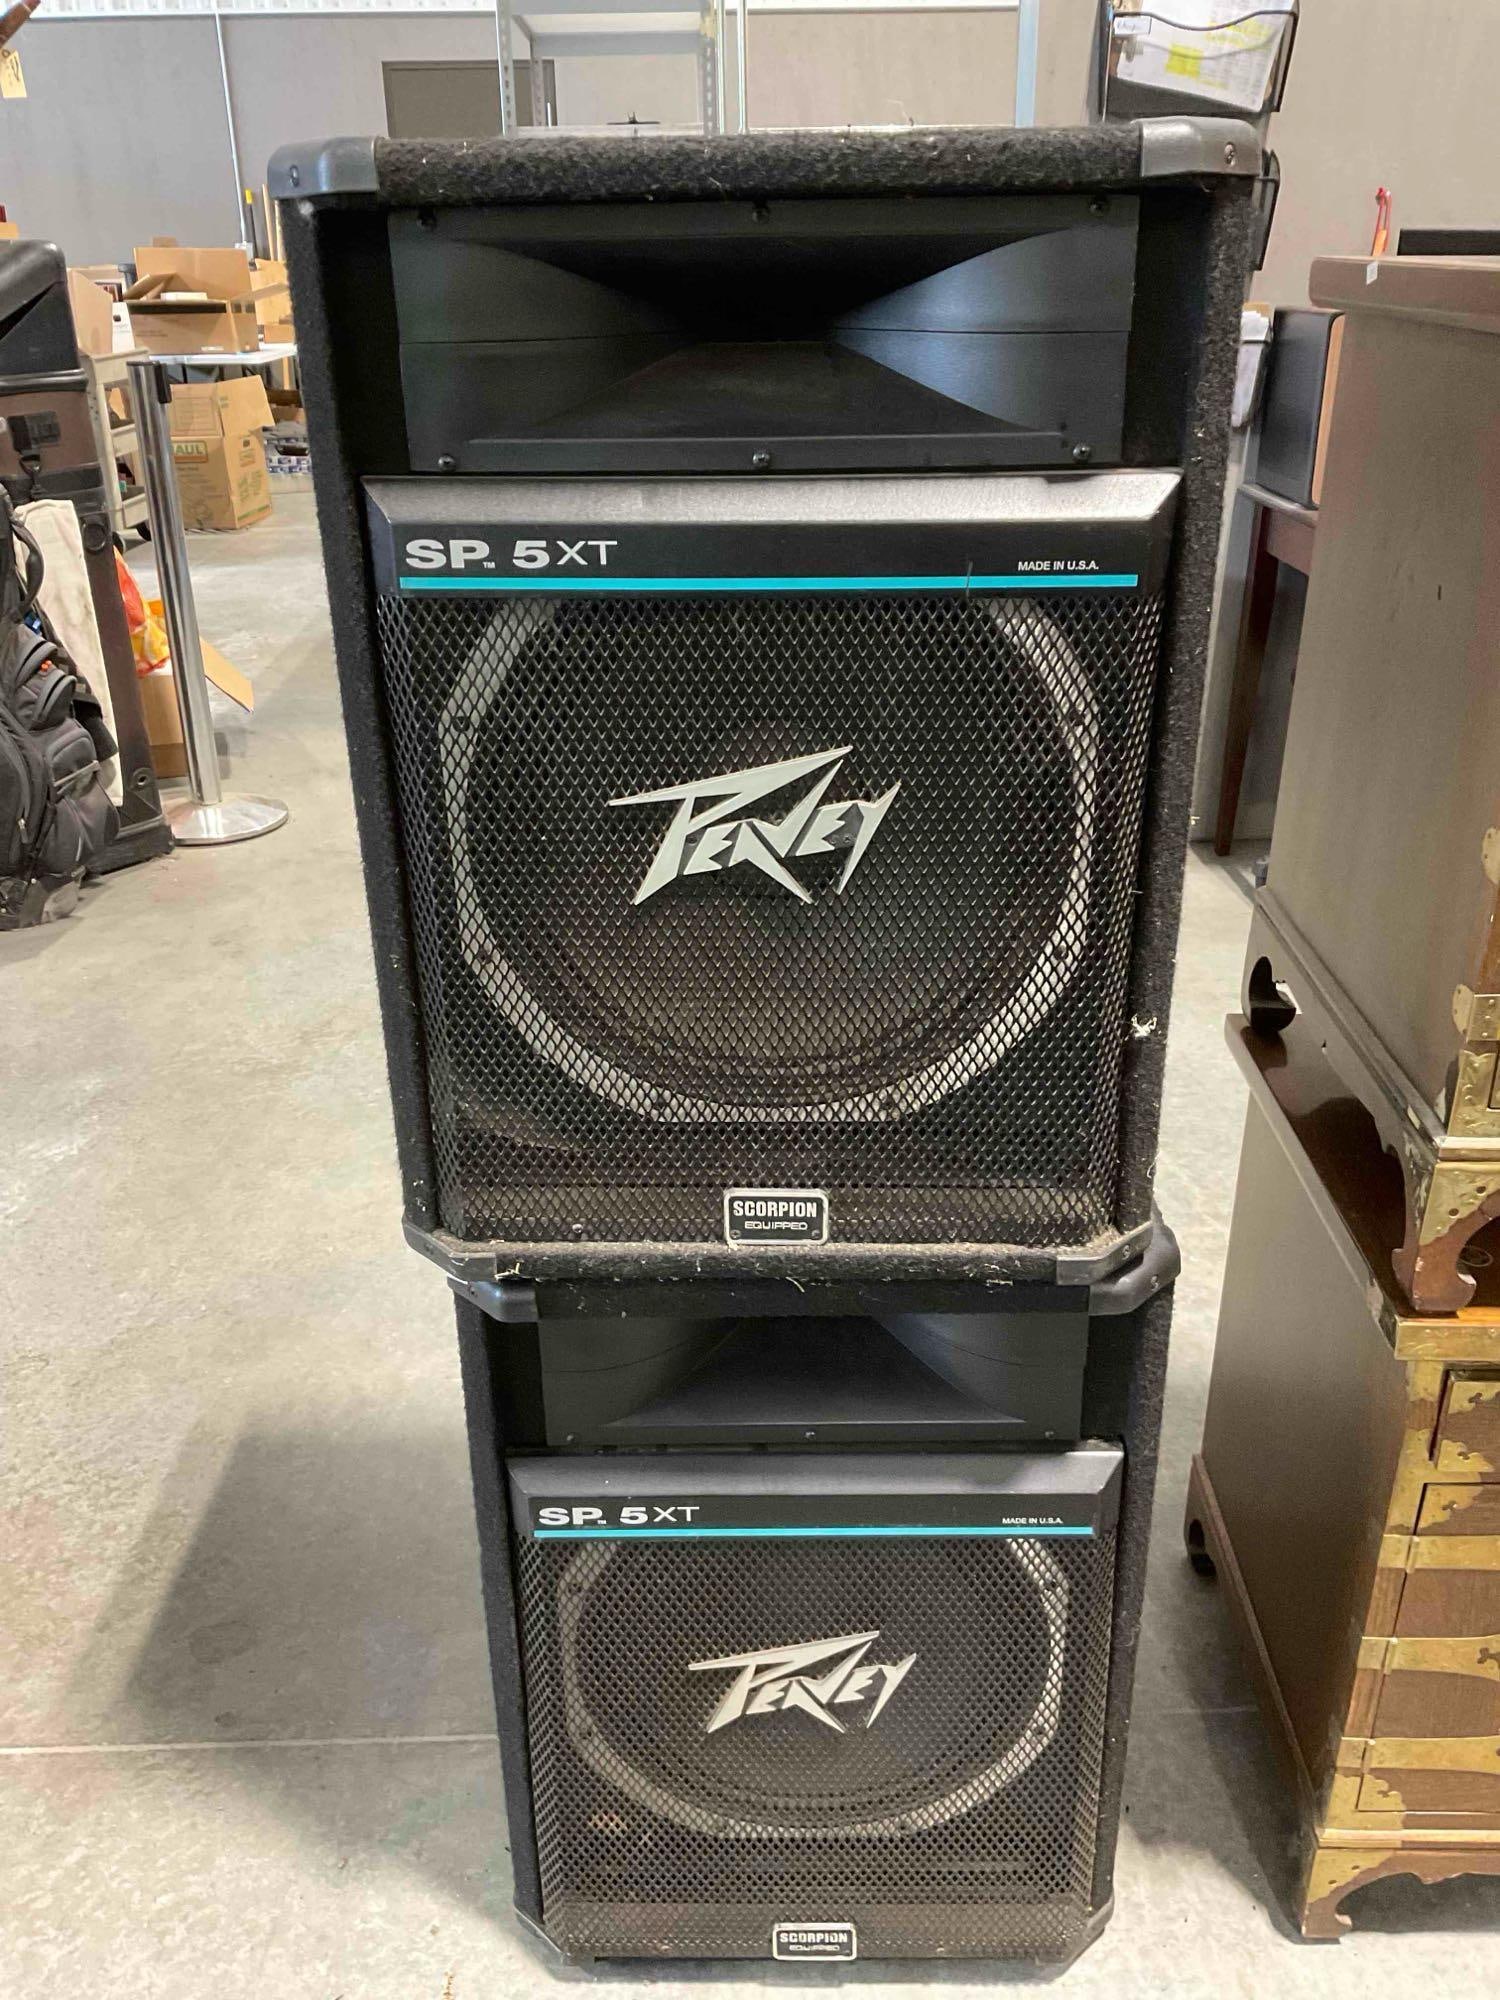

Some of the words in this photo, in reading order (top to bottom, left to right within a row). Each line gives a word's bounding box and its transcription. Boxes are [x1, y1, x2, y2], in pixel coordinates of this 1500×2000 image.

[1017, 561, 1051, 571] MADE
[1053, 561, 1065, 570] IN
[1067, 560, 1099, 570] U.S.A.
[608, 745, 902, 906] PEAVEY
[732, 1200, 817, 1218] SCORPION
[744, 1220, 808, 1231] EQUIPPED
[688, 1630, 917, 1734] PEAVEY
[779, 1932, 848, 1943] SCORPION
